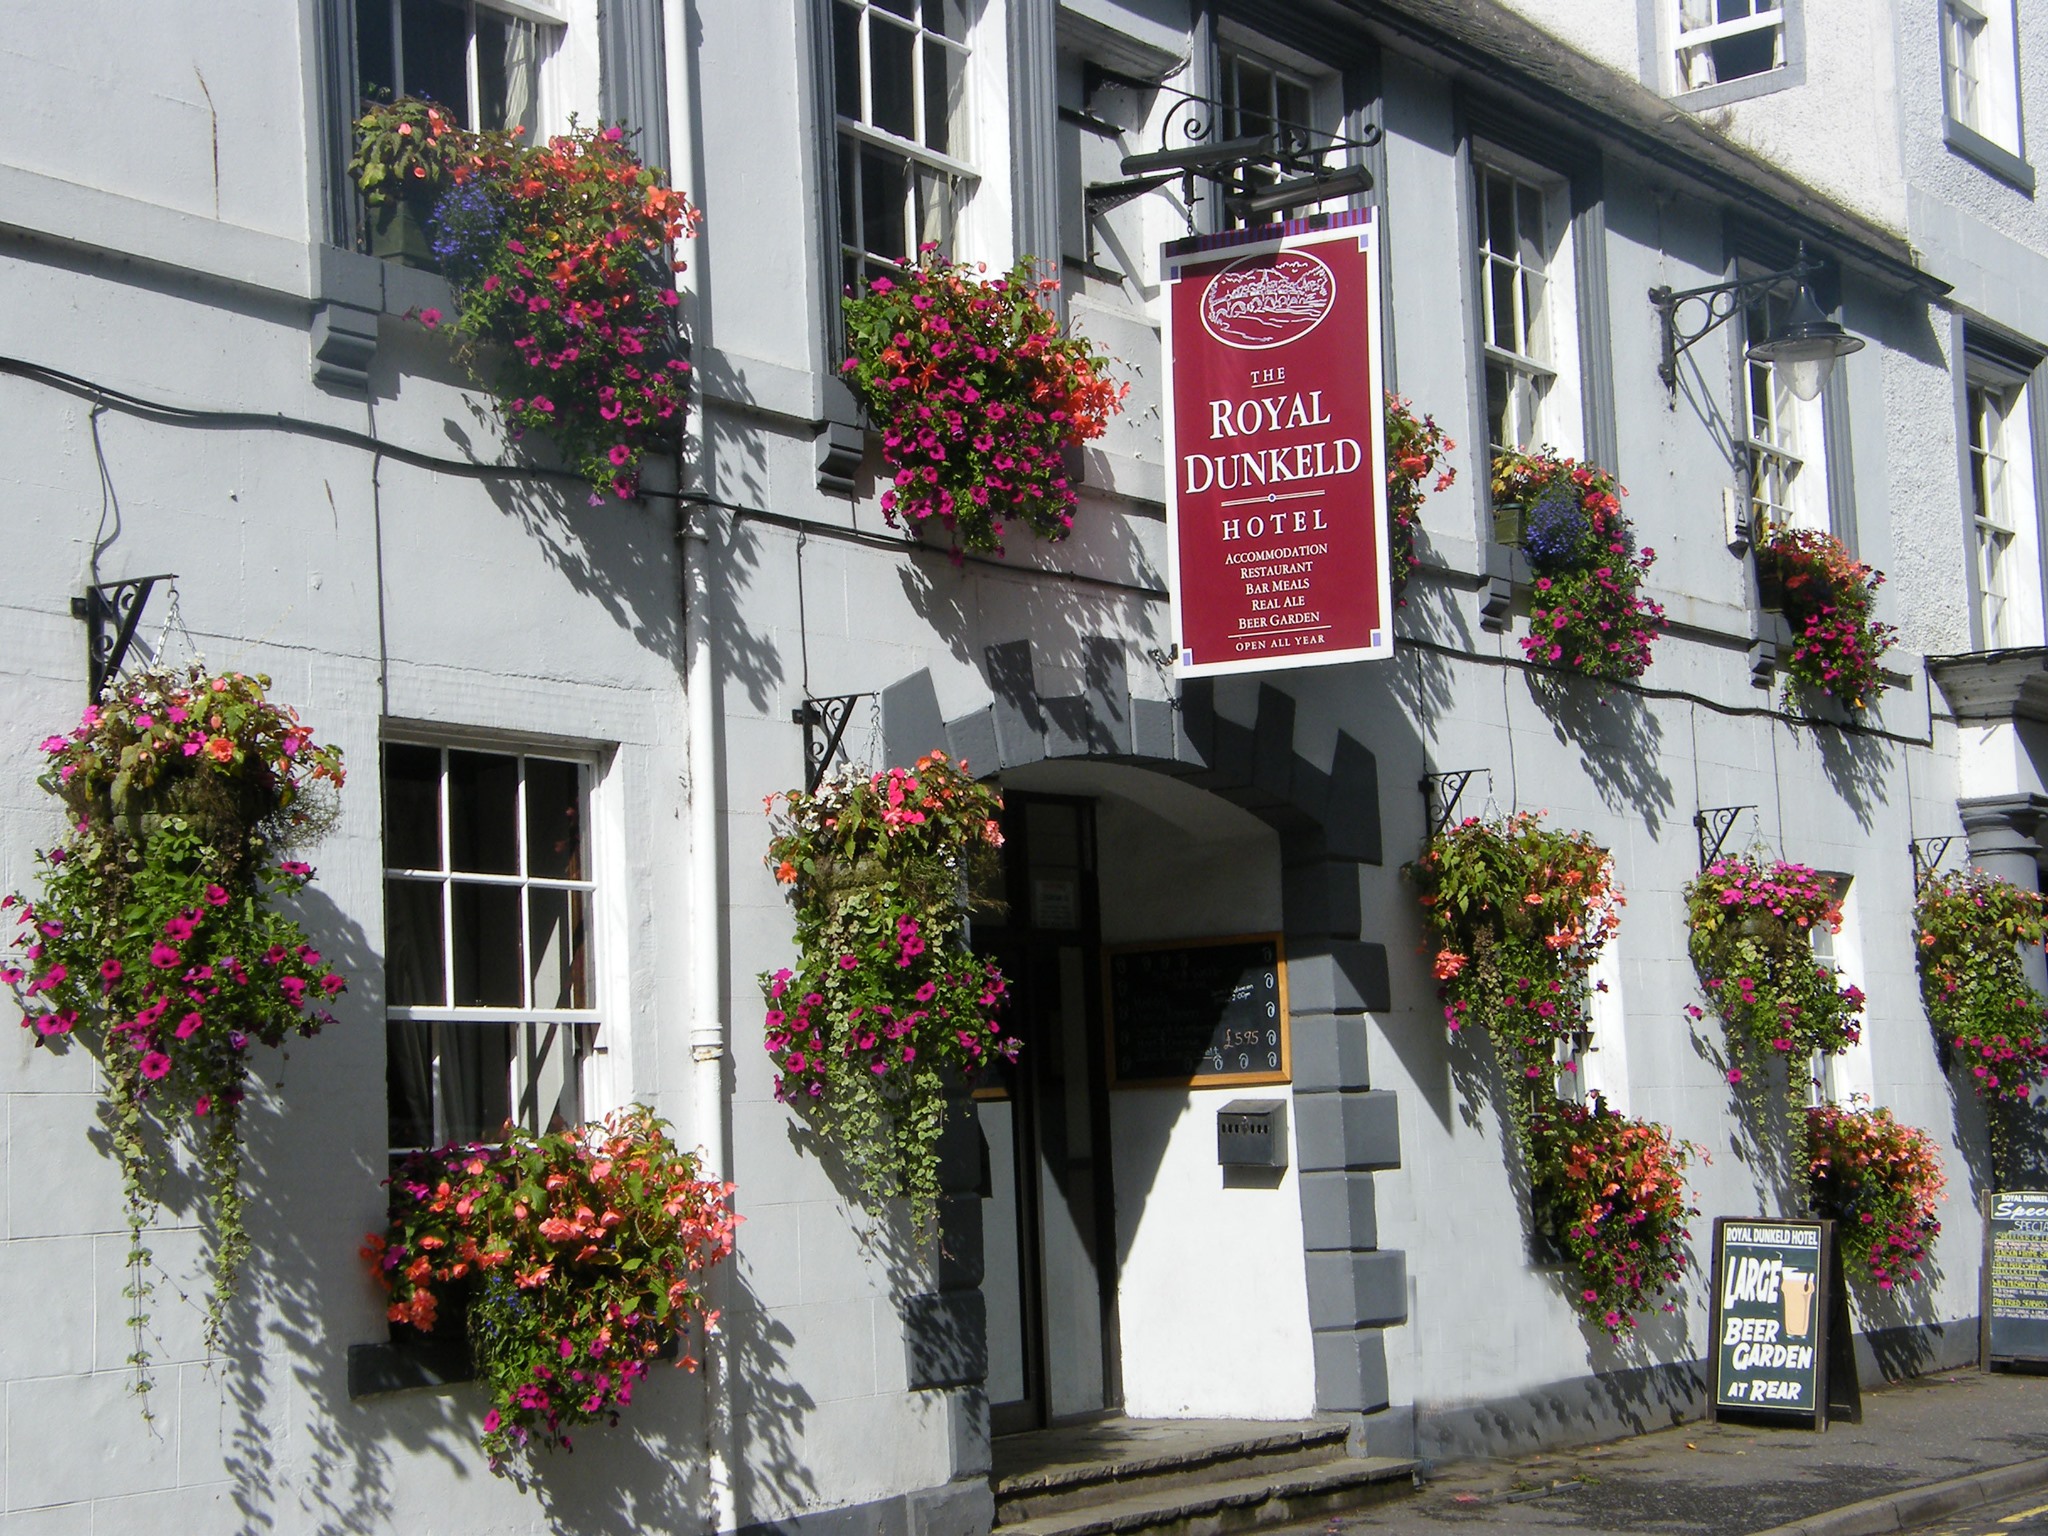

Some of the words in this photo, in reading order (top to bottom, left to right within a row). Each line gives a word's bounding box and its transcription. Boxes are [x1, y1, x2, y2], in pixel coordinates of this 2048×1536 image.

[1251, 367, 1285, 384] THE
[1209, 390, 1331, 439] ROYAL
[1184, 438, 1362, 494] DUNKELD
[1222, 509, 1327, 540] HOTEL
[1225, 543, 1328, 565] ACCOMMODATION
[1240, 561, 1313, 579] RESTAURANT
[1245, 582, 1270, 596] BAR
[1272, 578, 1310, 592] MEALS
[1252, 599, 1281, 611] REAL
[1283, 596, 1305, 607] ALE
[1239, 618, 1268, 630] BEER
[1270, 612, 1320, 626] GARDEN
[1236, 640, 1266, 652] OPEN
[1270, 638, 1290, 648] ALL
[1295, 634, 1325, 645] YEAR
[1726, 1227, 1752, 1242] ROYAL
[1753, 1228, 1790, 1244] DUNKELD
[1791, 1230, 1818, 1245] HOTEL
[1724, 1256, 1782, 1309] LARGE
[1723, 1317, 1779, 1345] BEER
[1732, 1342, 1813, 1371] GARDEN
[1727, 1382, 1749, 1398] AT
[1750, 1380, 1802, 1401] REAR
